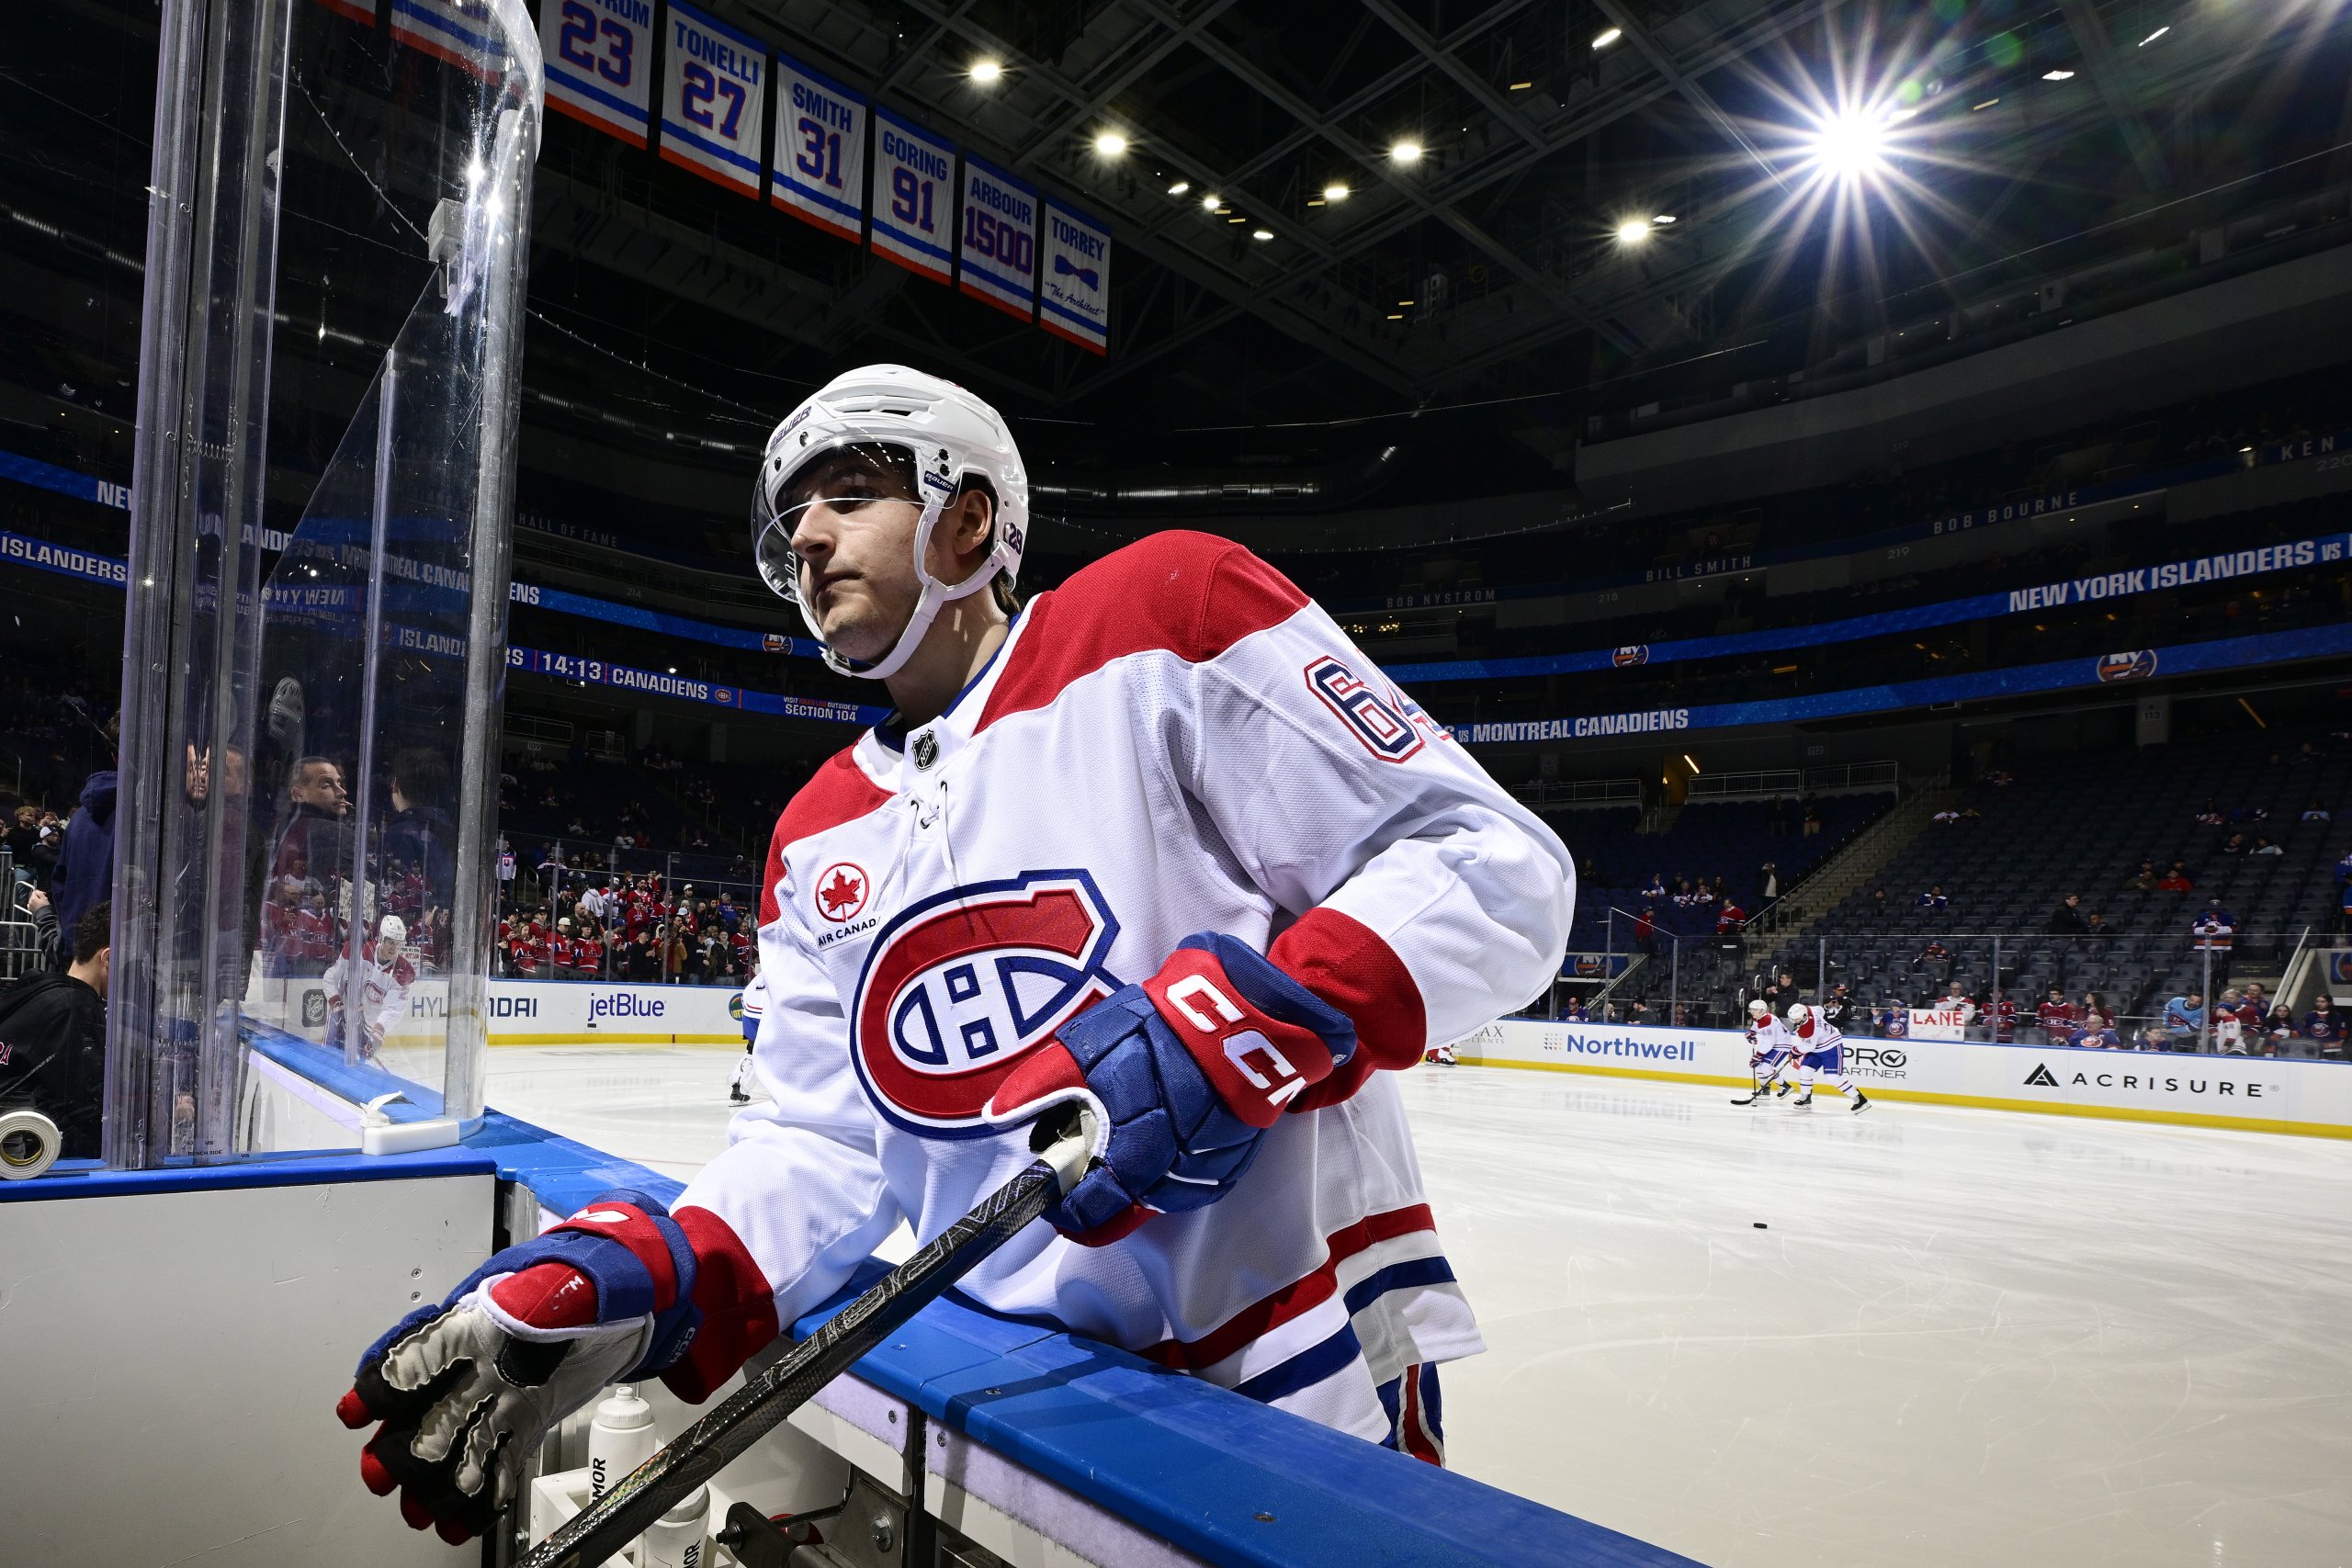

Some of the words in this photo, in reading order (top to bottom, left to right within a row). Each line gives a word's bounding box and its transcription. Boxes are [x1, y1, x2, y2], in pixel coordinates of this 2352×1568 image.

[596, 0, 650, 29] ROM
[559, 0, 633, 88] 23
[675, 19, 759, 85] TONELLI
[682, 61, 746, 141] 27
[793, 83, 853, 133] SMITH
[797, 117, 842, 189] 31
[883, 130, 947, 181] GORING
[892, 166, 934, 234] 91
[970, 176, 1032, 226] ARBOUR
[964, 206, 1034, 276] 1500
[1052, 216, 1105, 261] TORREY
[2281, 436, 2335, 461] KEN
[925, 472, 955, 491] BAUER
[519, 513, 553, 531] HALL
[560, 523, 576, 536] OF
[583, 529, 618, 547] FAME
[1933, 514, 1973, 535] BOB
[1988, 491, 2077, 524] BOURNE
[2, 536, 127, 581] ISLANDERS
[1646, 566, 1683, 582] BILL
[1695, 556, 1751, 576] SMITH
[1887, 547, 1909, 559] 219
[2009, 582, 2068, 612] NEW
[2075, 570, 2144, 601] YORK
[2151, 540, 2315, 590] ISLANDERS
[2322, 542, 2341, 560] VS
[1386, 596, 1414, 608] BOB
[1423, 589, 1496, 604] NYSTROM
[543, 653, 602, 680] 14:13
[613, 668, 708, 701] CANADIENS
[786, 704, 833, 719] SECTION
[836, 710, 856, 721] 104
[1473, 719, 1571, 742] MONTREAL
[1576, 708, 1689, 738] CANADIENS
[818, 933, 834, 947] AIR
[835, 918, 879, 940] CANAD
[412, 996, 537, 1018] HYDAI
[588, 993, 665, 1021] jetBlue
[1914, 1011, 1965, 1026] LANE
[1474, 1026, 1503, 1038] AX
[1566, 1034, 1694, 1061] Northwell
[1842, 1067, 1906, 1079] ARTNER
[2072, 1073, 2262, 1097] ACRISURE
[592, 1458, 606, 1502] MOR
